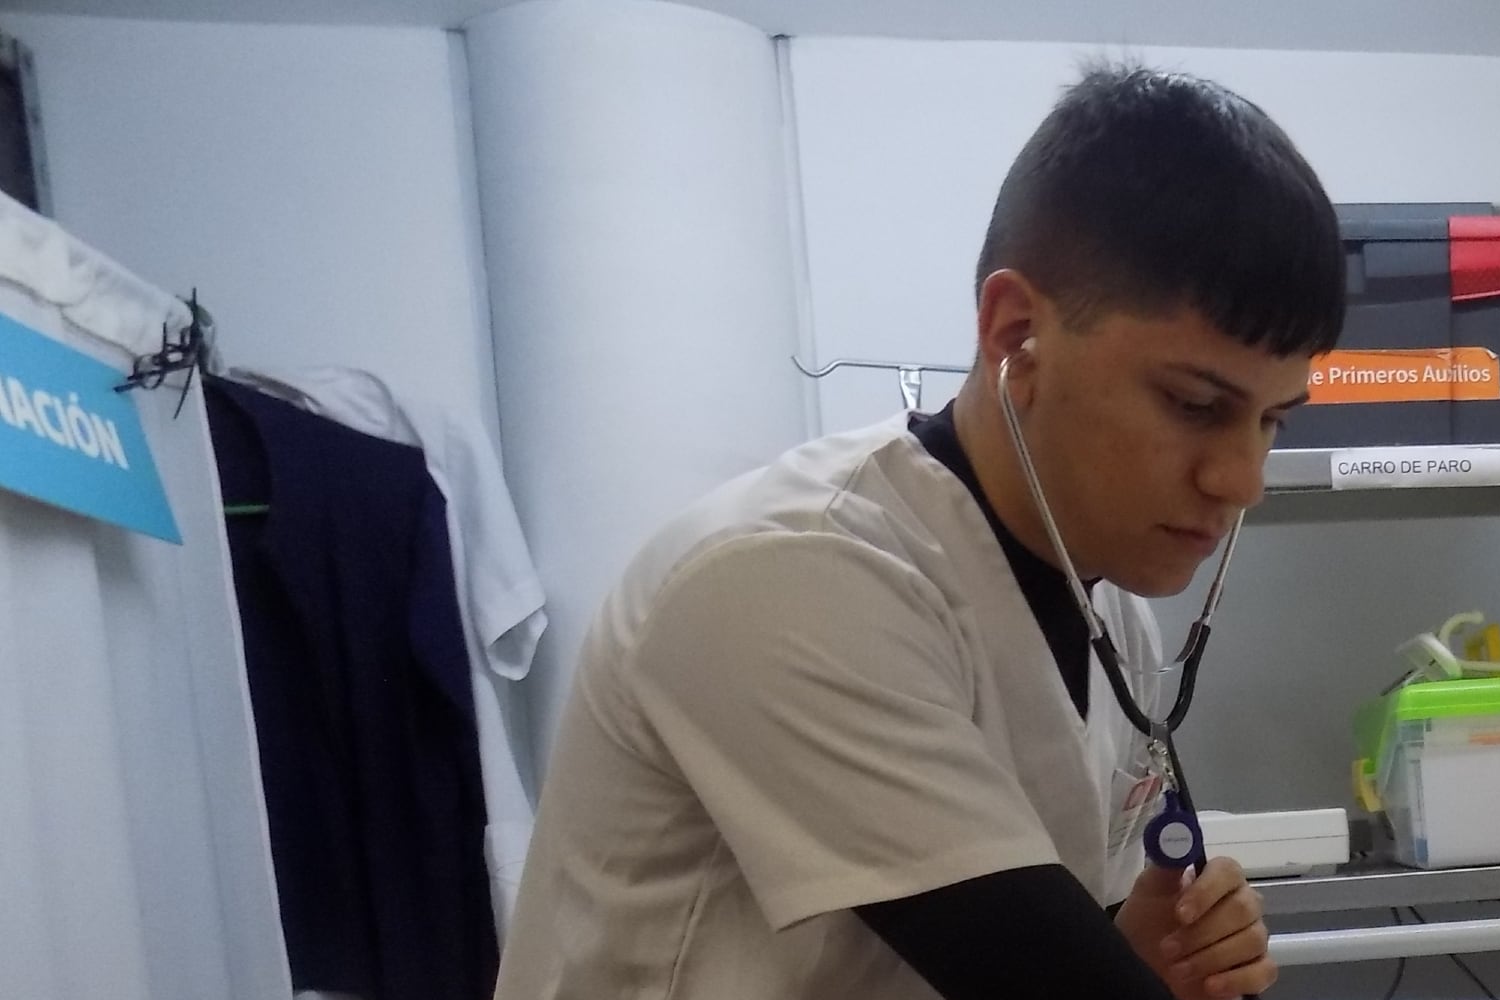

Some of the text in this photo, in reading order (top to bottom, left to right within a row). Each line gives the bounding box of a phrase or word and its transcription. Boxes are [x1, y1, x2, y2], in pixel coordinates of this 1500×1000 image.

[1329, 365, 1418, 385] Primeros
[1338, 459, 1472, 475] CARRO DE PARO
